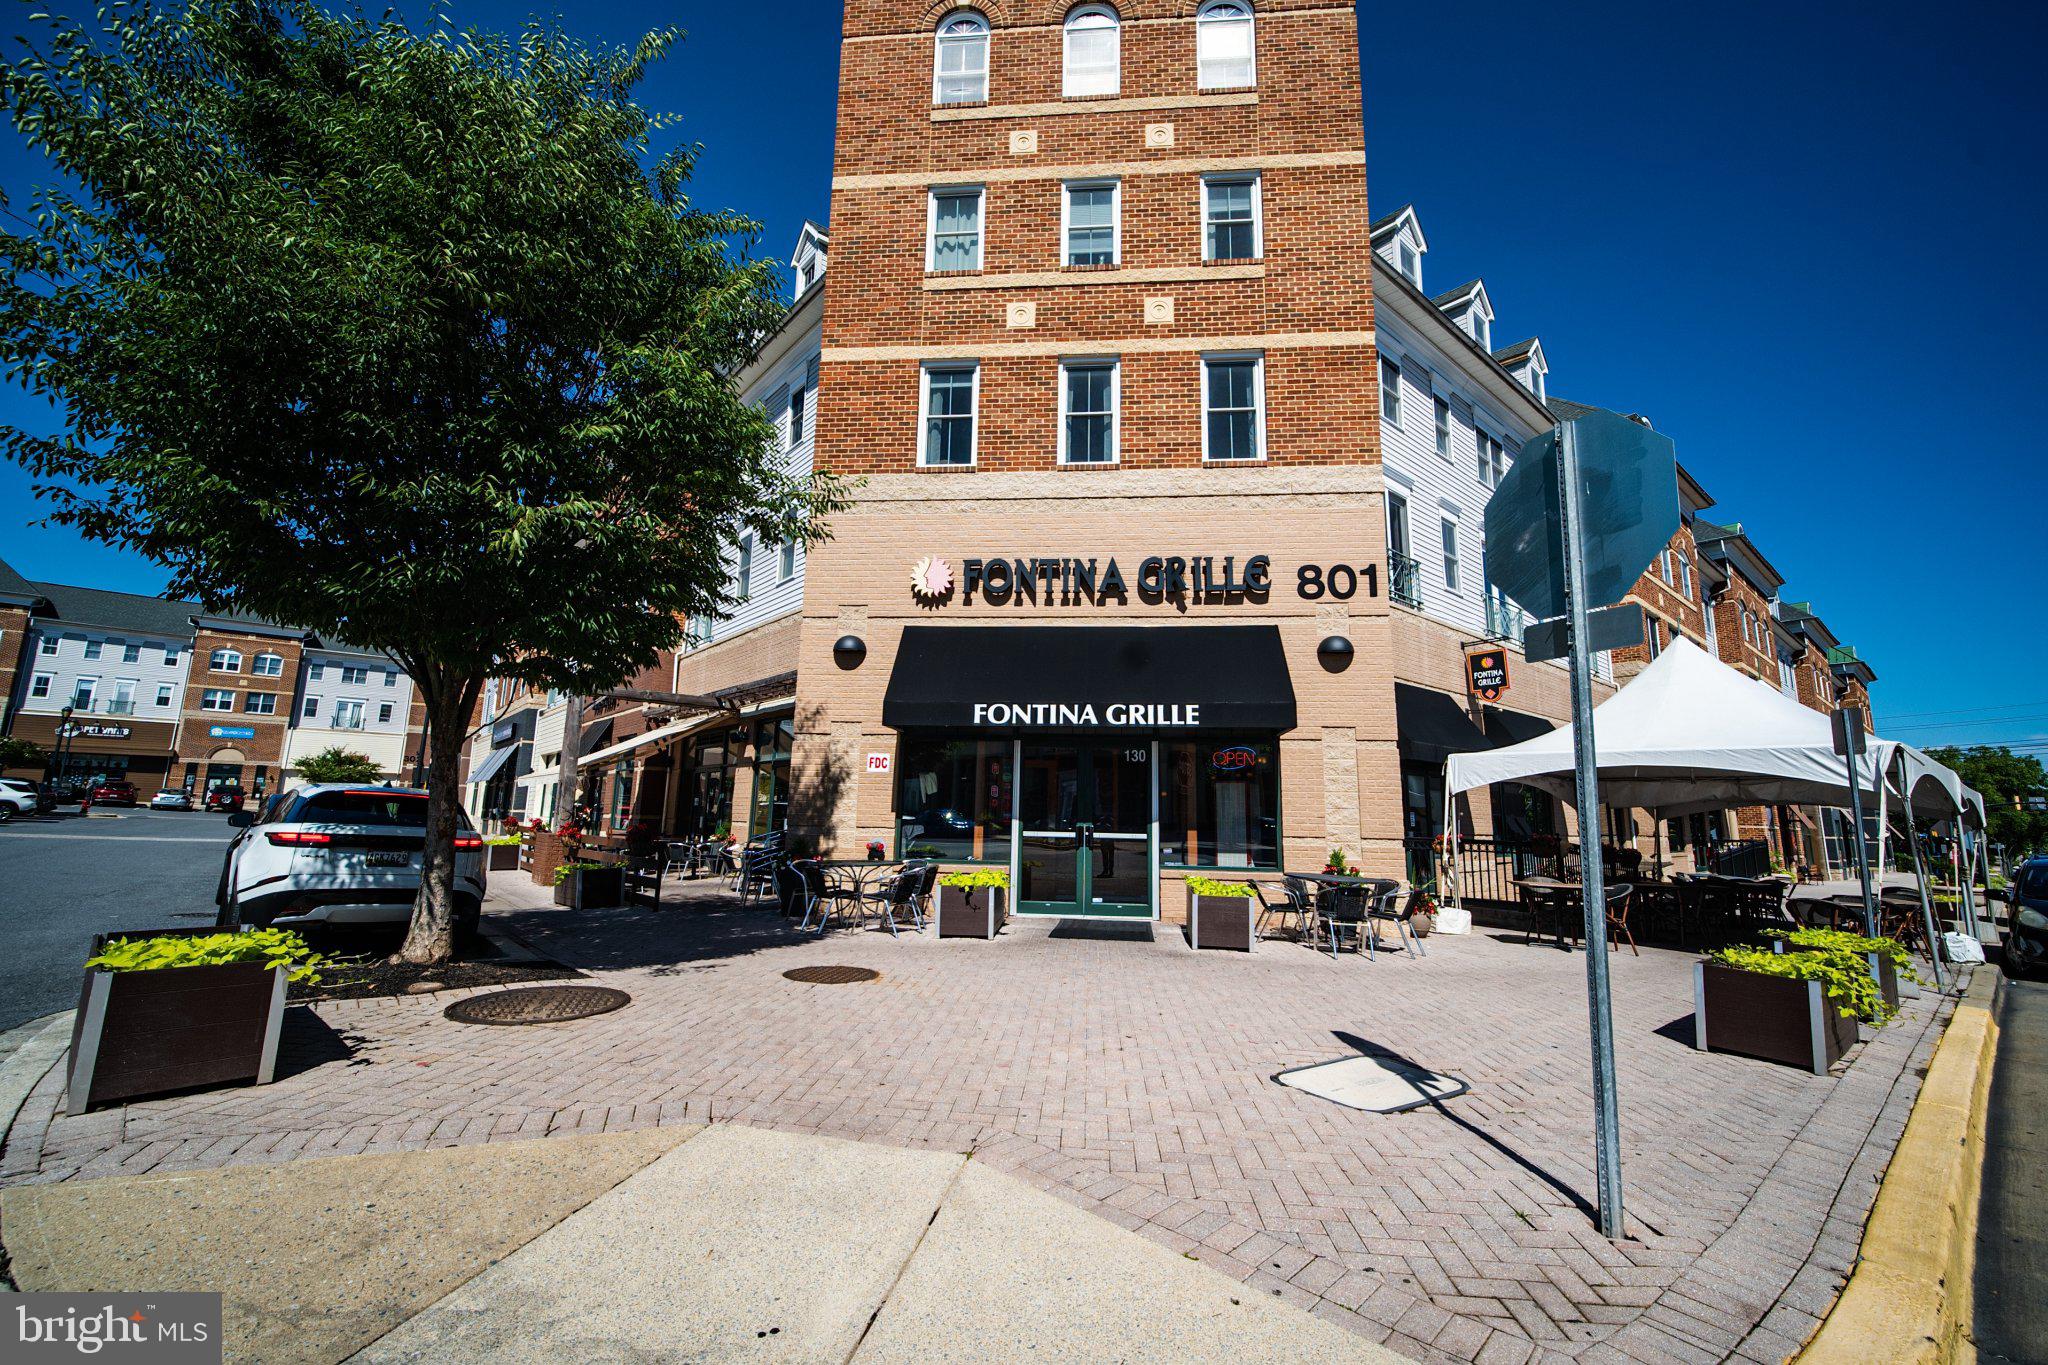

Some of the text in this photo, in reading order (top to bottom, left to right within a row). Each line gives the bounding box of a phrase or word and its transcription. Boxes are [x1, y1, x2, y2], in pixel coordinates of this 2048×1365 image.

[963, 555, 1272, 593] FONTINA GRILLE
[1296, 563, 1379, 599] 801
[1473, 669, 1504, 680] FONTINA
[1477, 676, 1502, 687] GRILLE
[973, 702, 1200, 726] FONTINA GRILLE
[83, 725, 99, 734] PET
[1124, 749, 1146, 762] 130
[1212, 751, 1256, 767] OPEN
[868, 757, 889, 769] FDC
